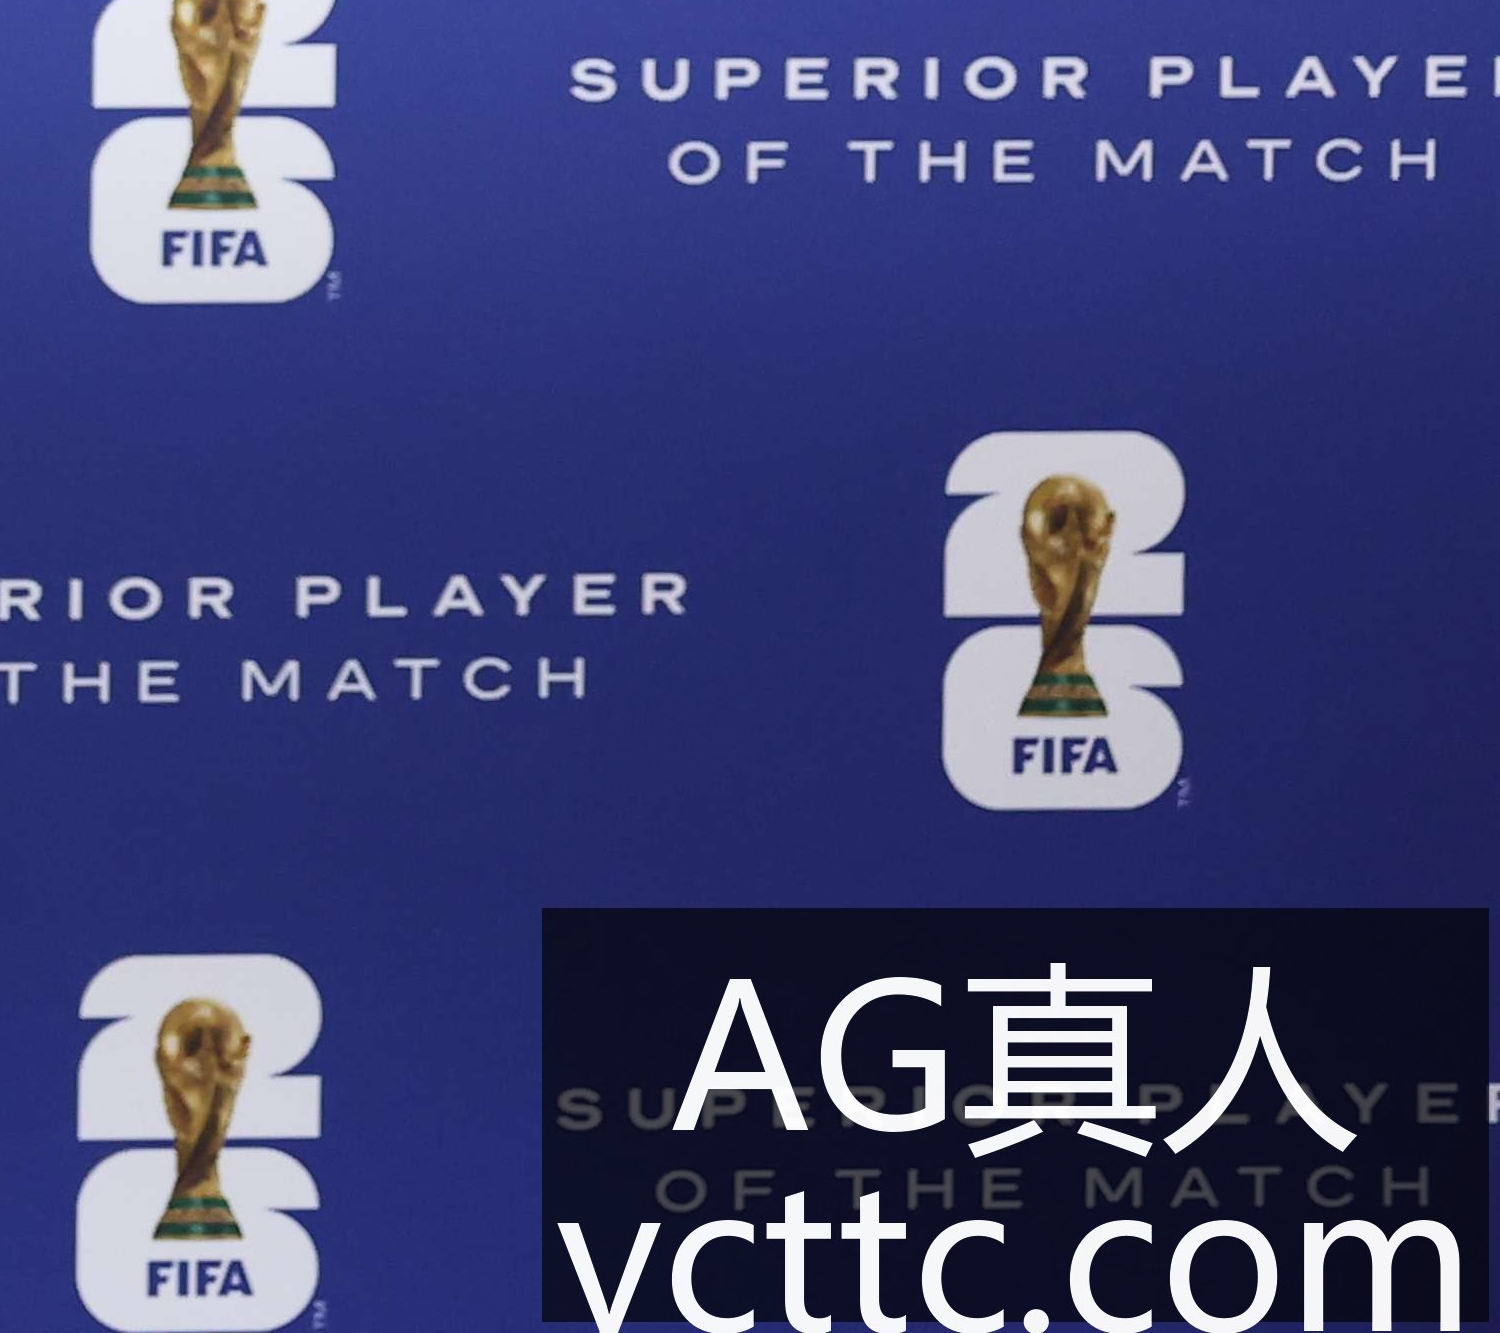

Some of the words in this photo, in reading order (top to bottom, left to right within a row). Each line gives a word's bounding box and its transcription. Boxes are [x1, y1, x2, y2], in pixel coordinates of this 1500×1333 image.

[569, 55, 1089, 103] SUPERIOR
[1149, 54, 1500, 99] PLAYE
[667, 140, 789, 186] OF
[846, 139, 1035, 184] THE
[1095, 138, 1436, 183] MATCH
[161, 229, 268, 268] FIFA
[295, 572, 687, 619] PLAYER
[241, 656, 586, 702] MATCH
[1012, 736, 1119, 775] FIFA
[1084, 1164, 1430, 1210] MATCH
[147, 1259, 254, 1298] FIFA
